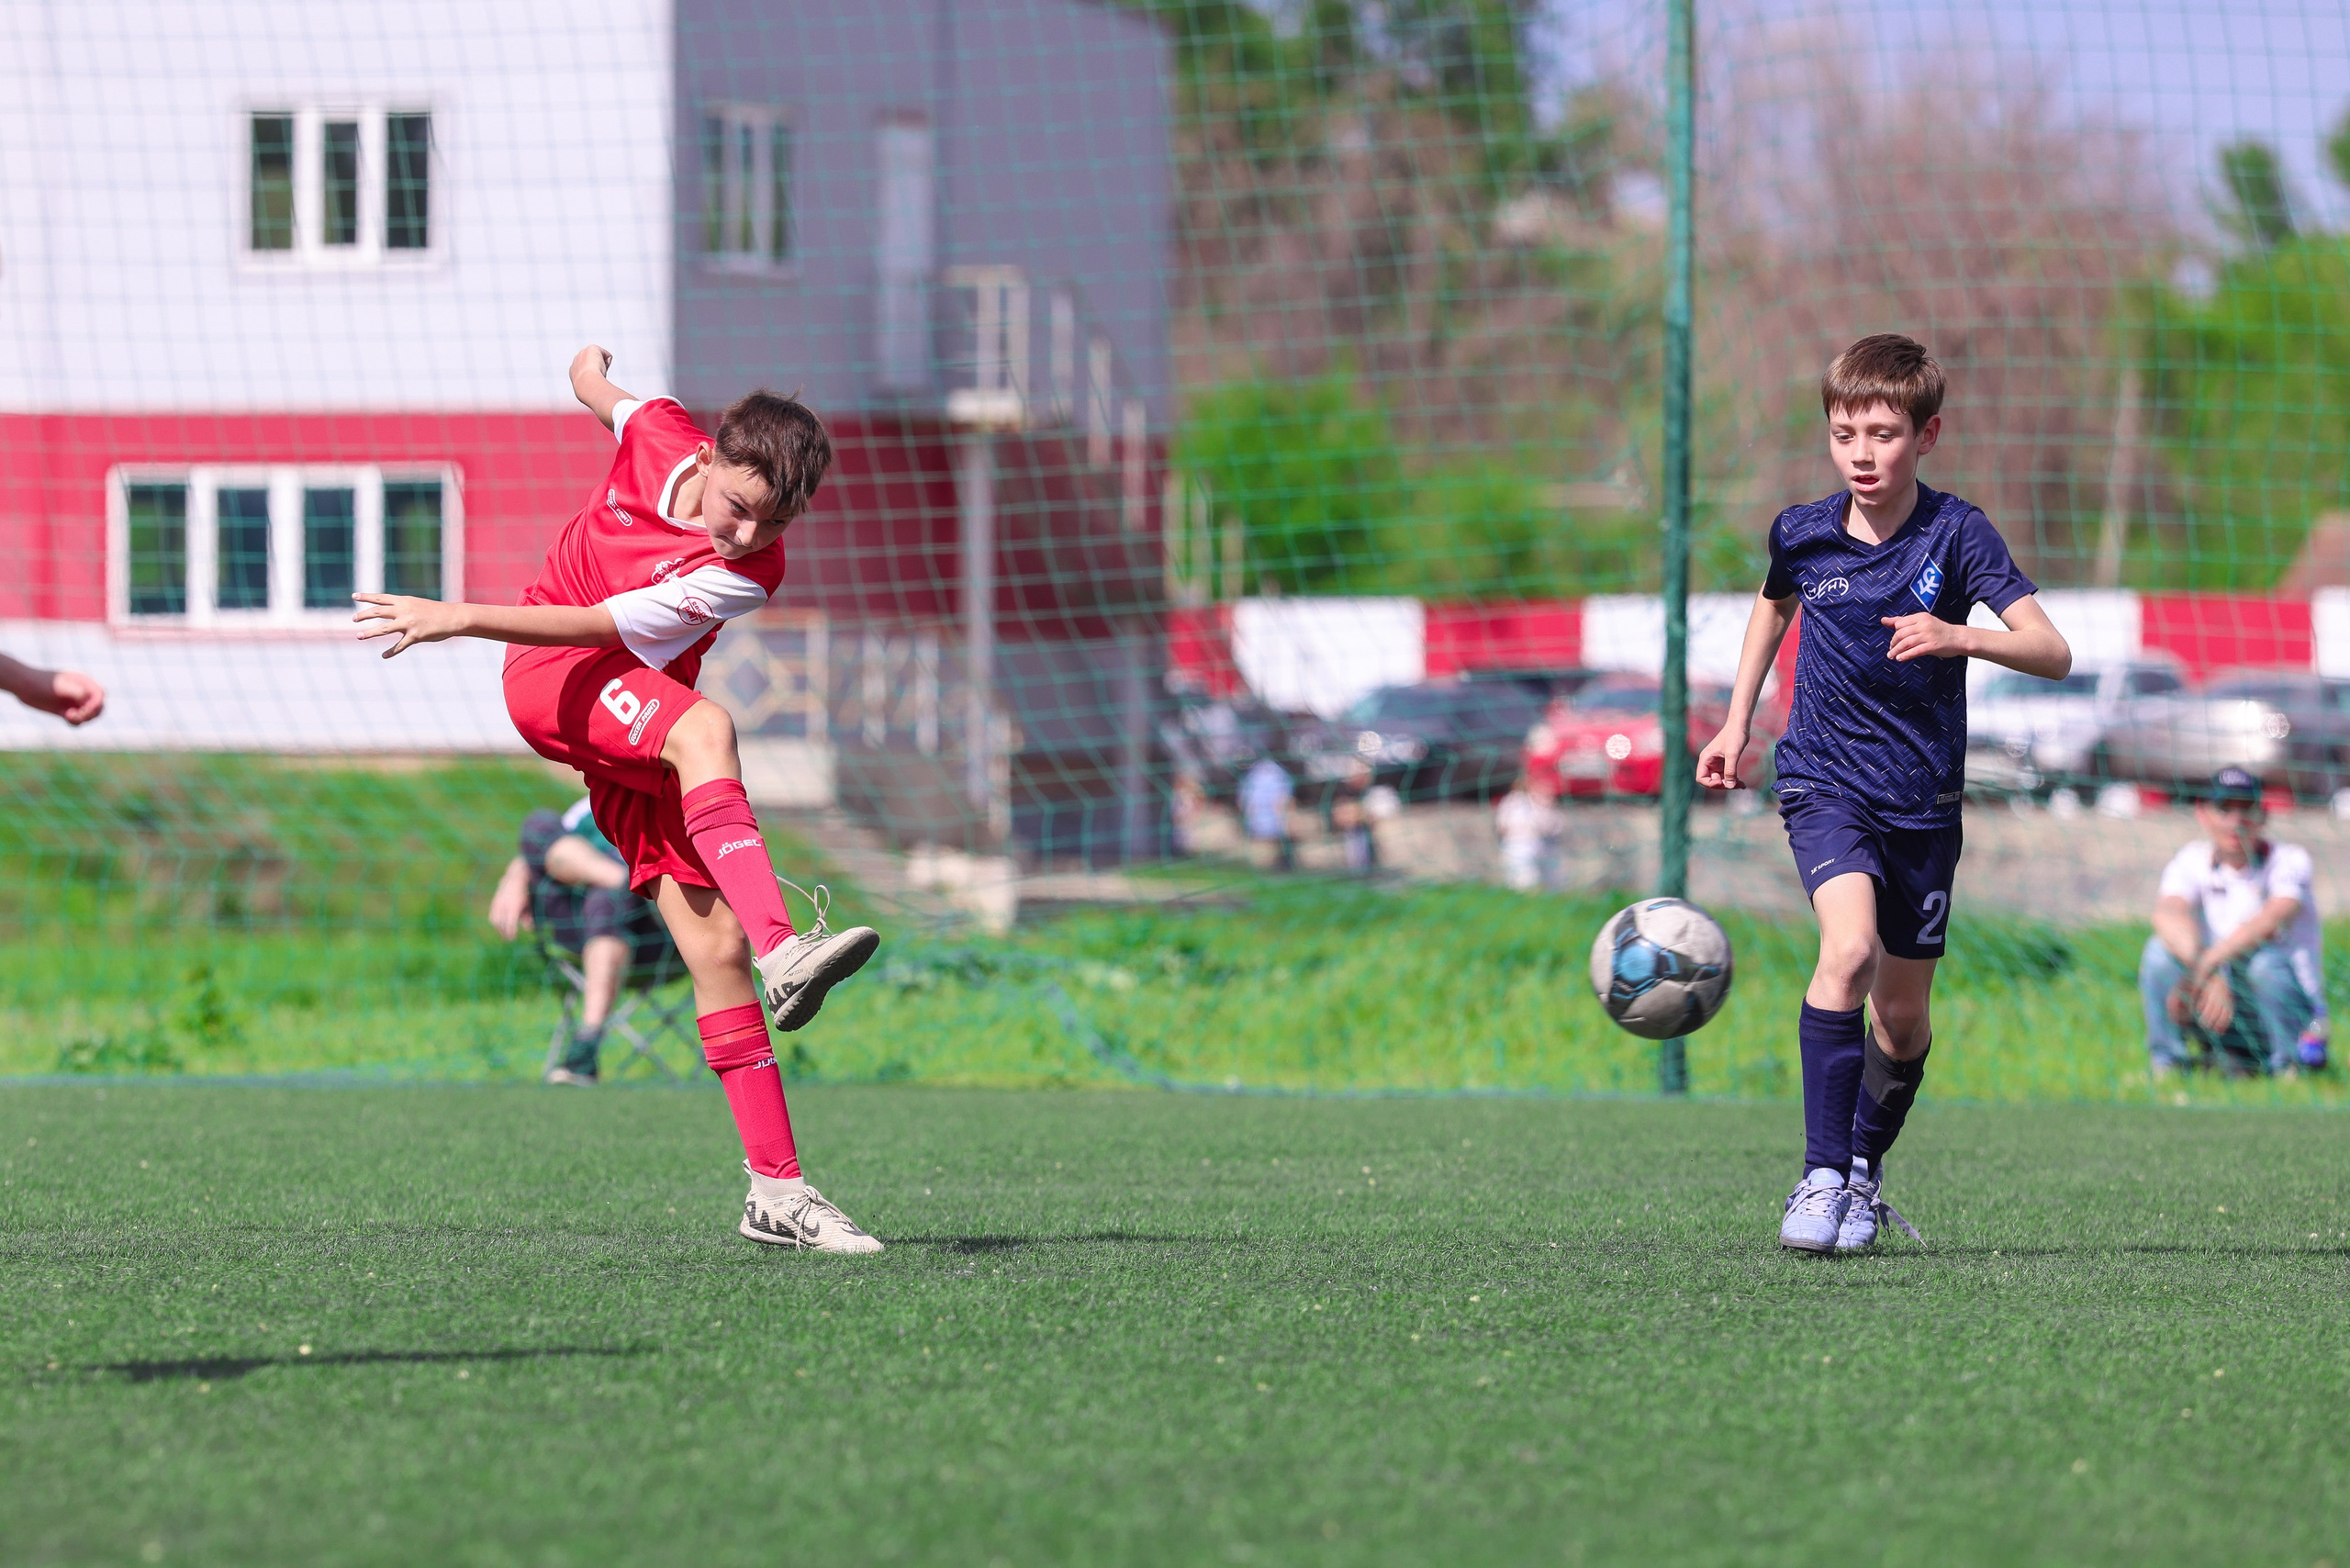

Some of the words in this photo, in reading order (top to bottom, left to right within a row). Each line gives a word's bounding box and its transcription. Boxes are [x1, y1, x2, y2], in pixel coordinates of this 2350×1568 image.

[599, 678, 641, 725] 6
[716, 838, 762, 860] JÖGEL
[1818, 858, 1836, 870] SPORT
[1916, 881, 1953, 945] 2
